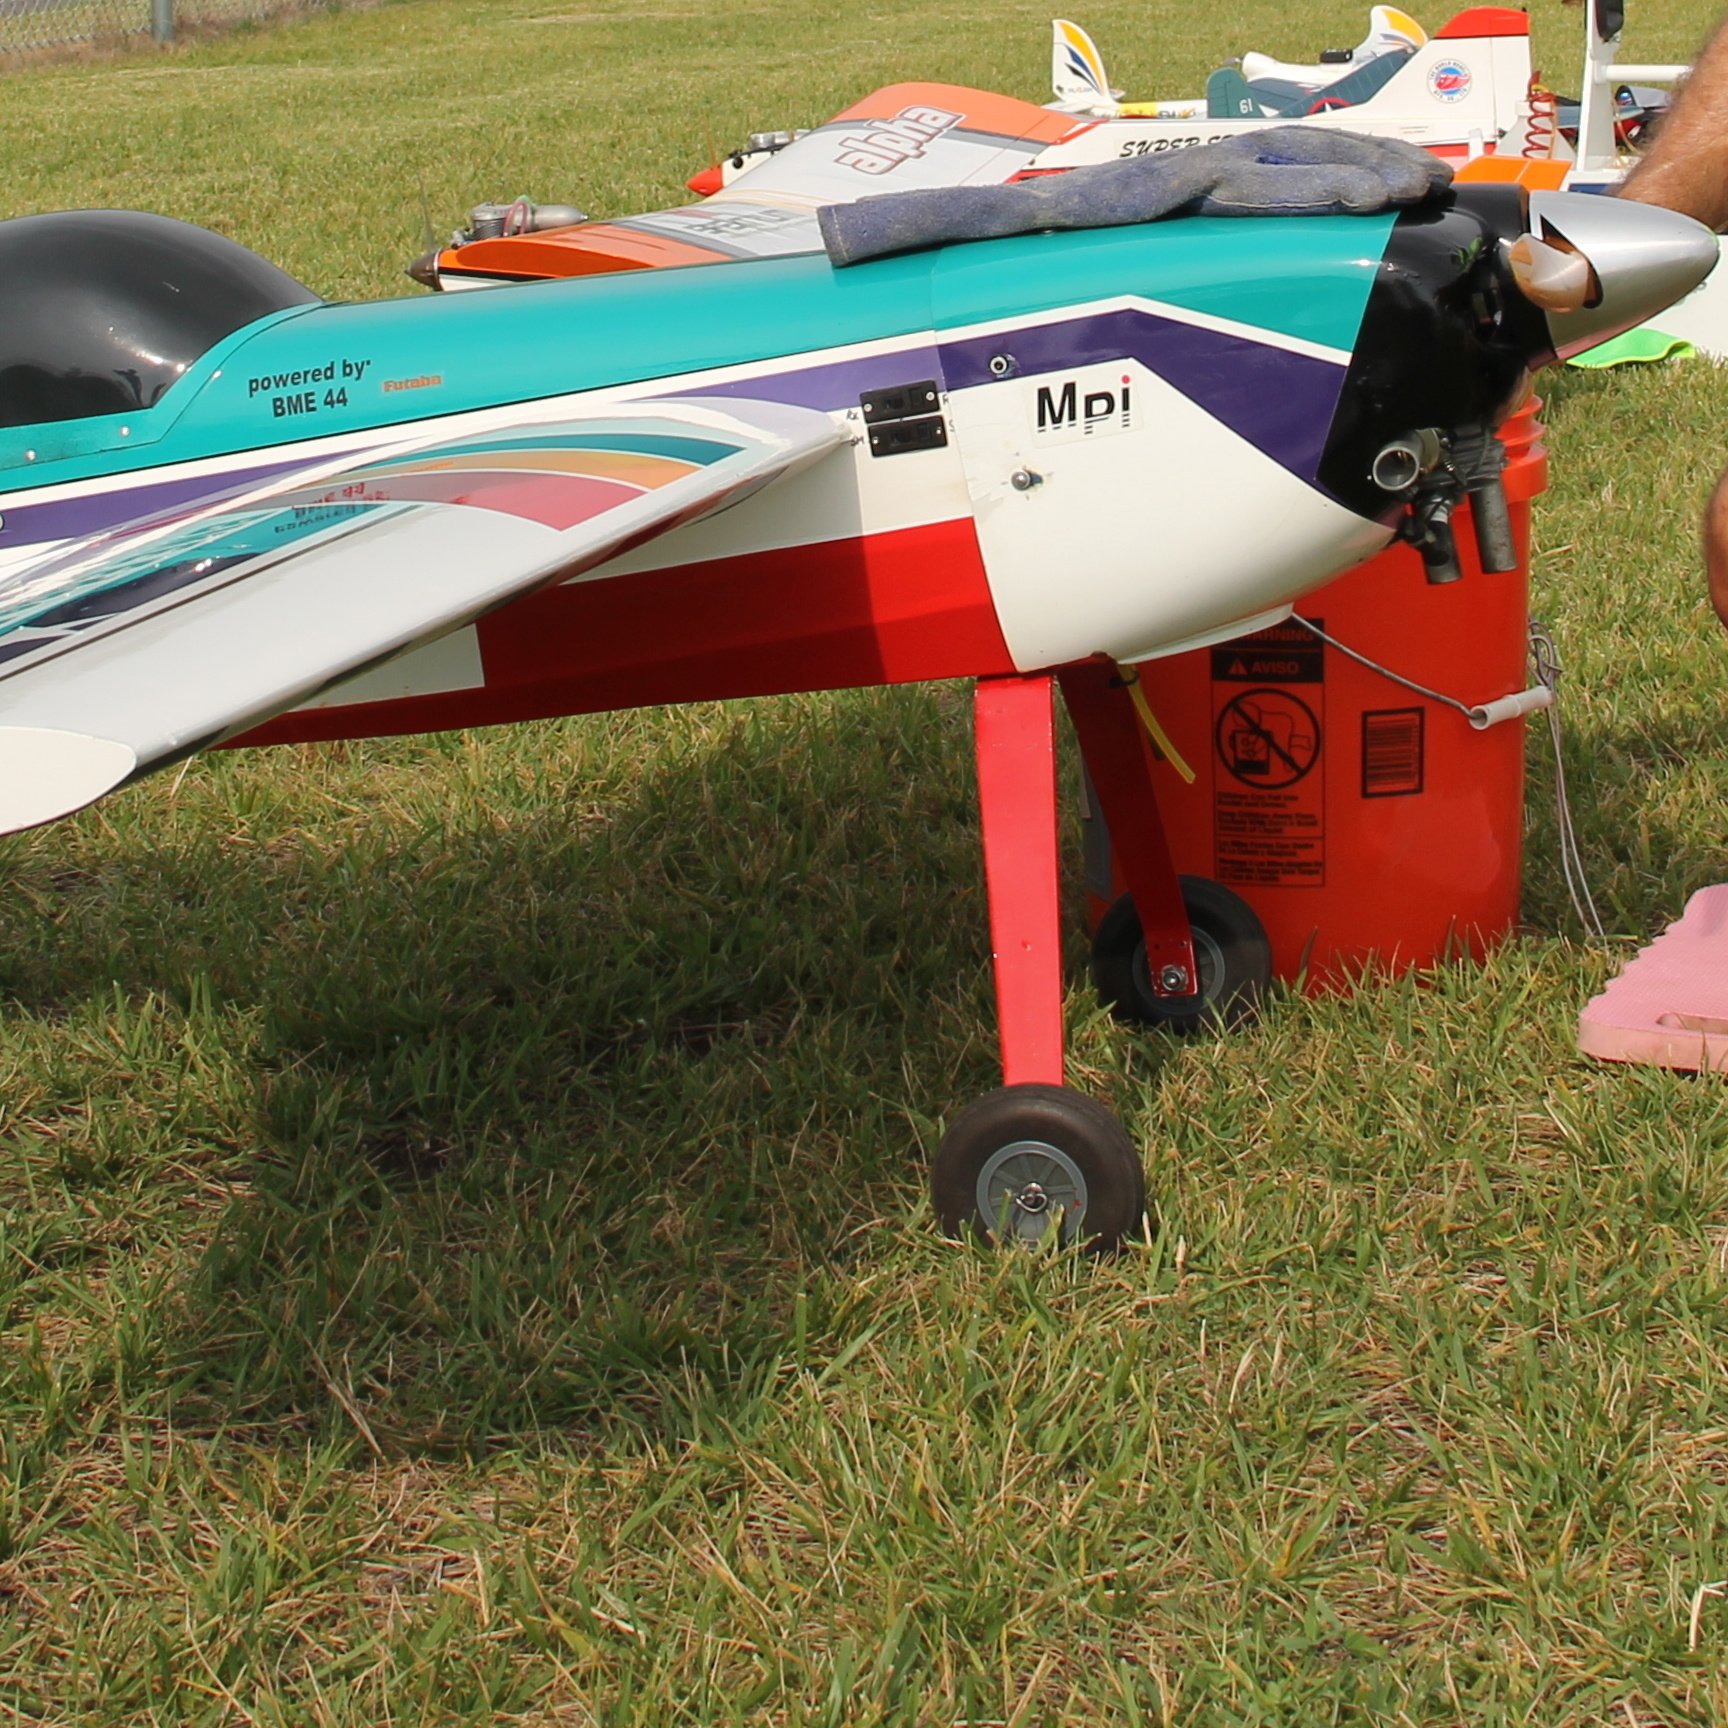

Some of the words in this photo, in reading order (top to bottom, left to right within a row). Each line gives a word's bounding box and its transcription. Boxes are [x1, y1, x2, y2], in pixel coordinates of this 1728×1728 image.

[1239, 98, 1253, 114] 61
[834, 106, 967, 175] alpha
[248, 361, 335, 398] powered
[272, 391, 317, 418] BME
[323, 387, 348, 409] 44
[1248, 627, 1314, 642] ARNING
[1251, 660, 1300, 675] AVISO
